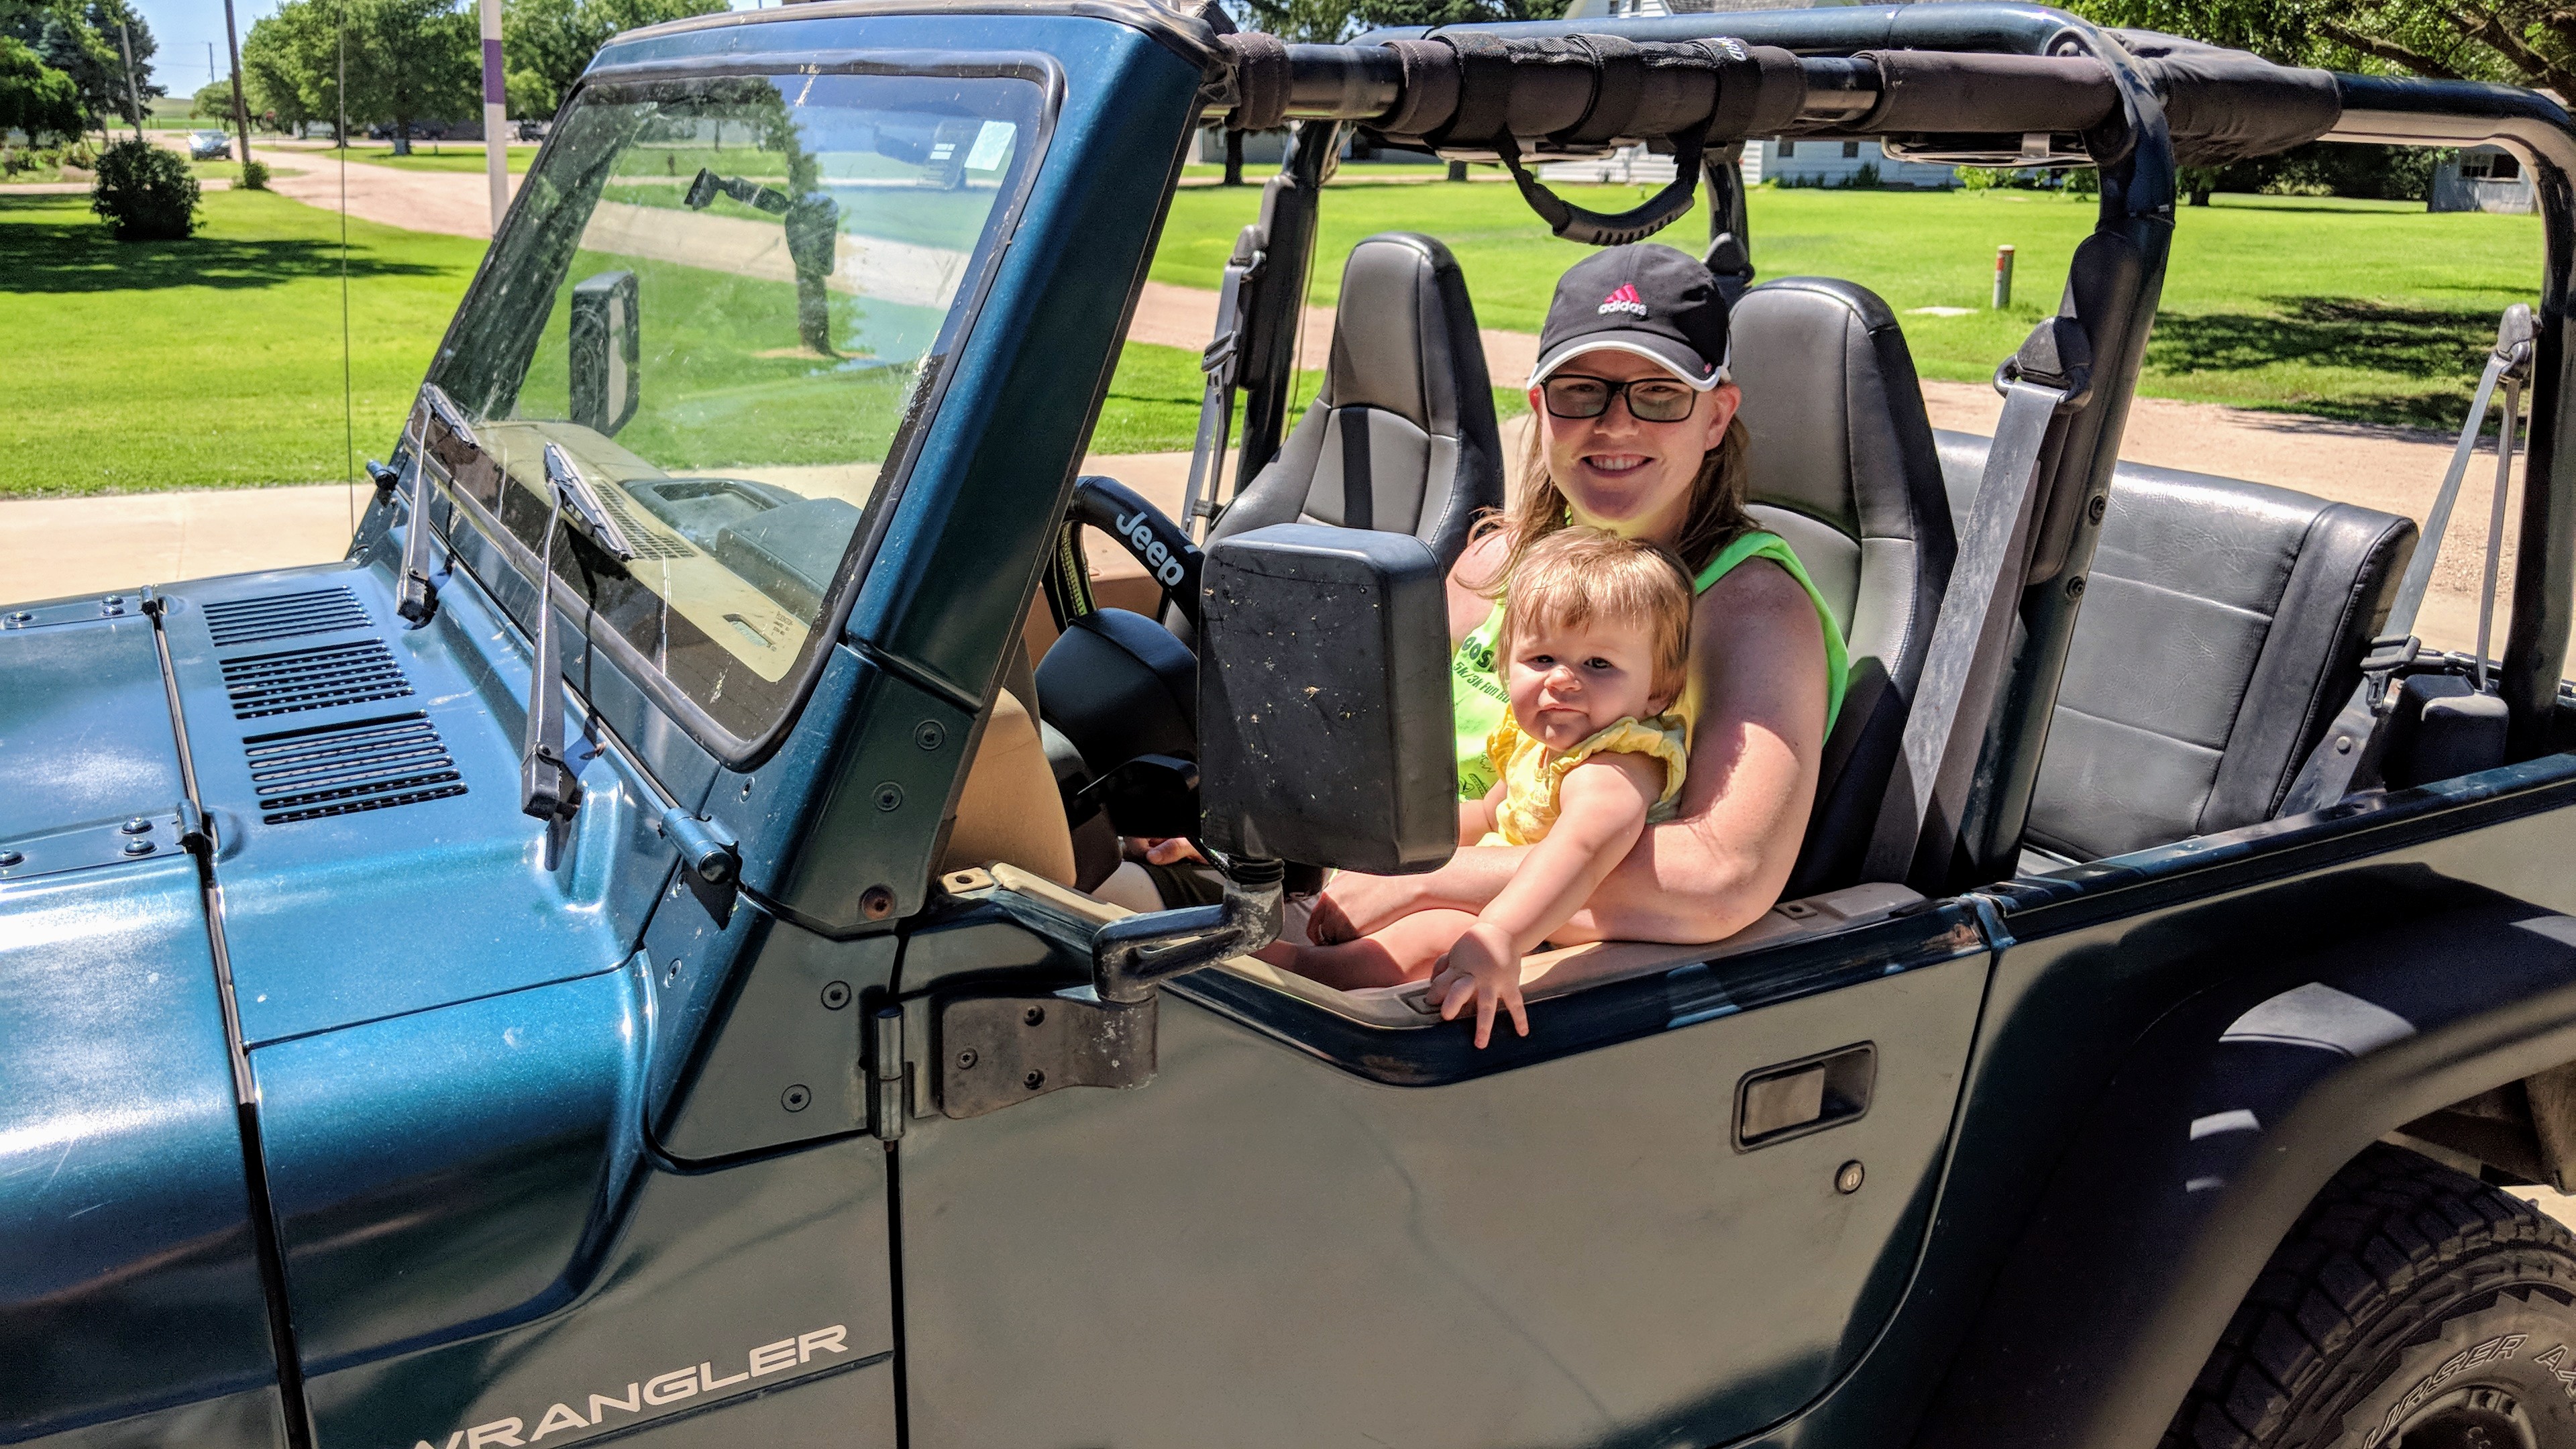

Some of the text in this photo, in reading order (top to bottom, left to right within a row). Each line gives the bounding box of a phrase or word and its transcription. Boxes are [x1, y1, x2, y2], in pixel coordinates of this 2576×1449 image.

[1598, 300, 1647, 315] adidas
[1116, 512, 1184, 586] Jeep
[2363, 1334, 2528, 1449] URSER
